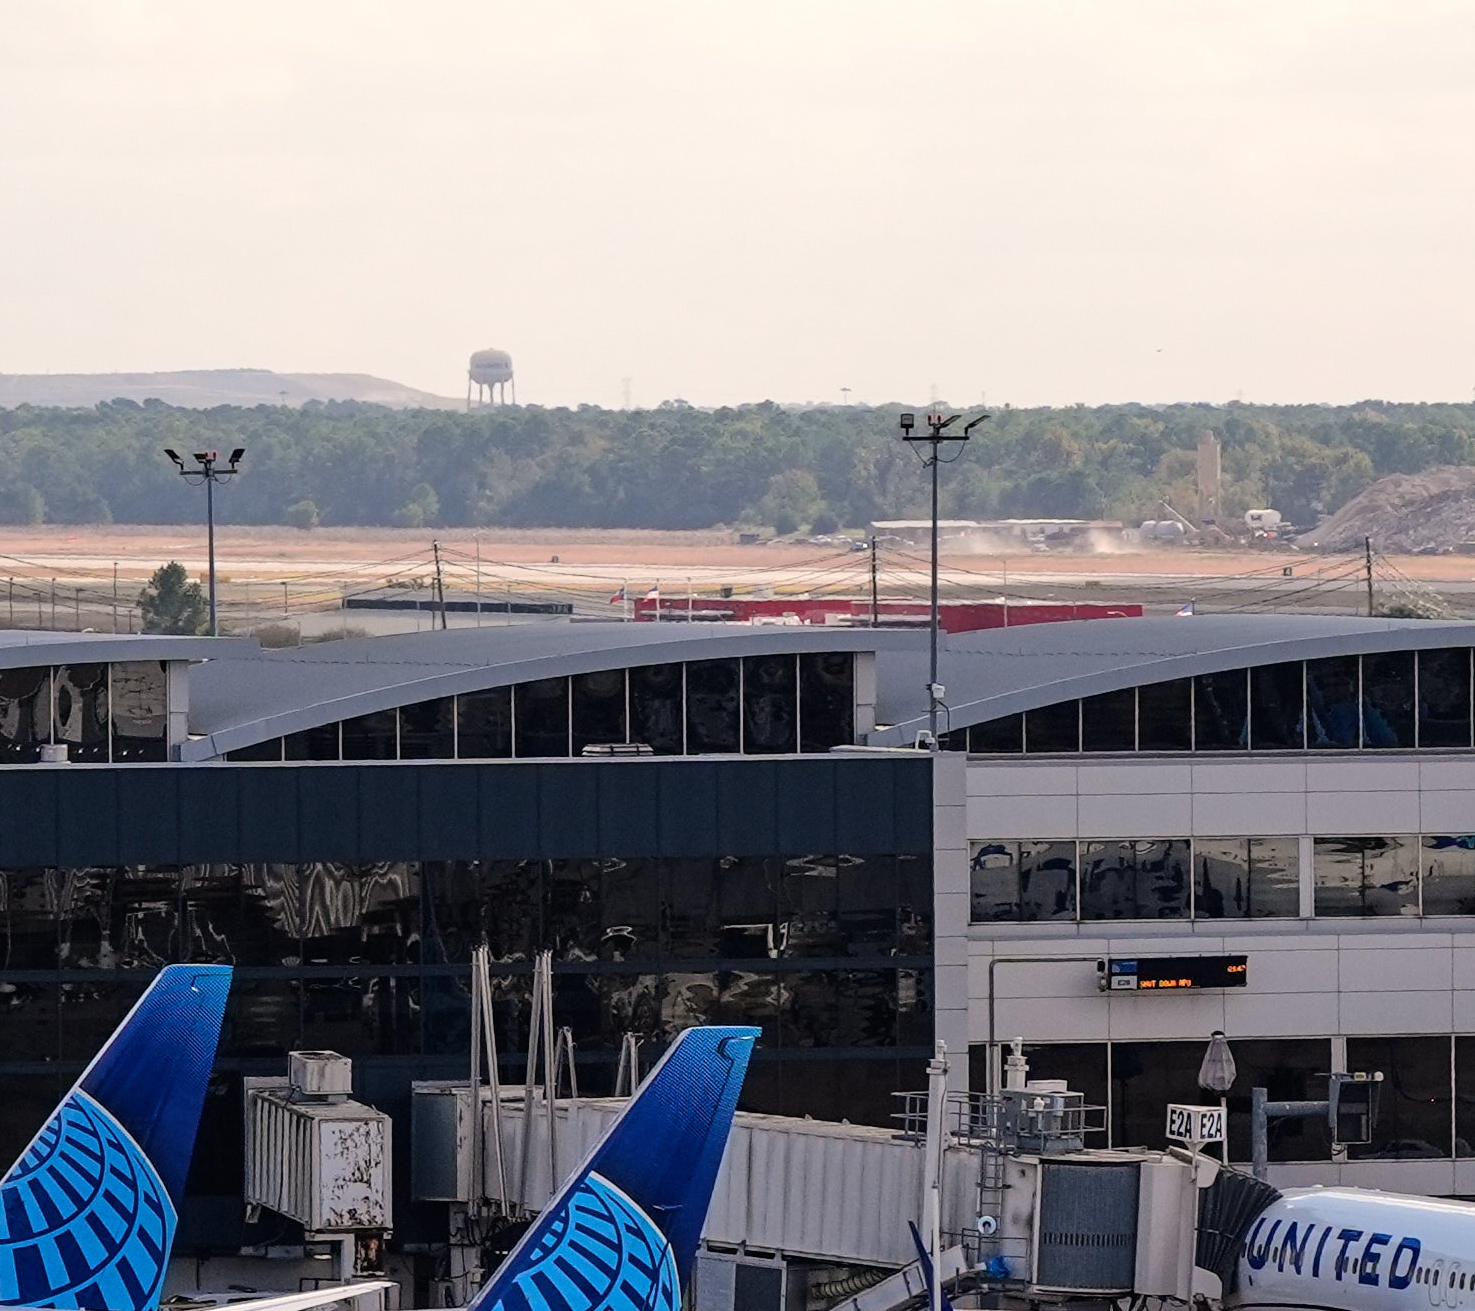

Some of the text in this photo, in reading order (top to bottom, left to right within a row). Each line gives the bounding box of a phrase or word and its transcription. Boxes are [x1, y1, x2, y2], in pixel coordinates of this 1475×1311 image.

[1169, 1109, 1192, 1139] E2A
[1200, 1113, 1222, 1139] E2A
[1247, 1217, 1421, 1289] UNITED
